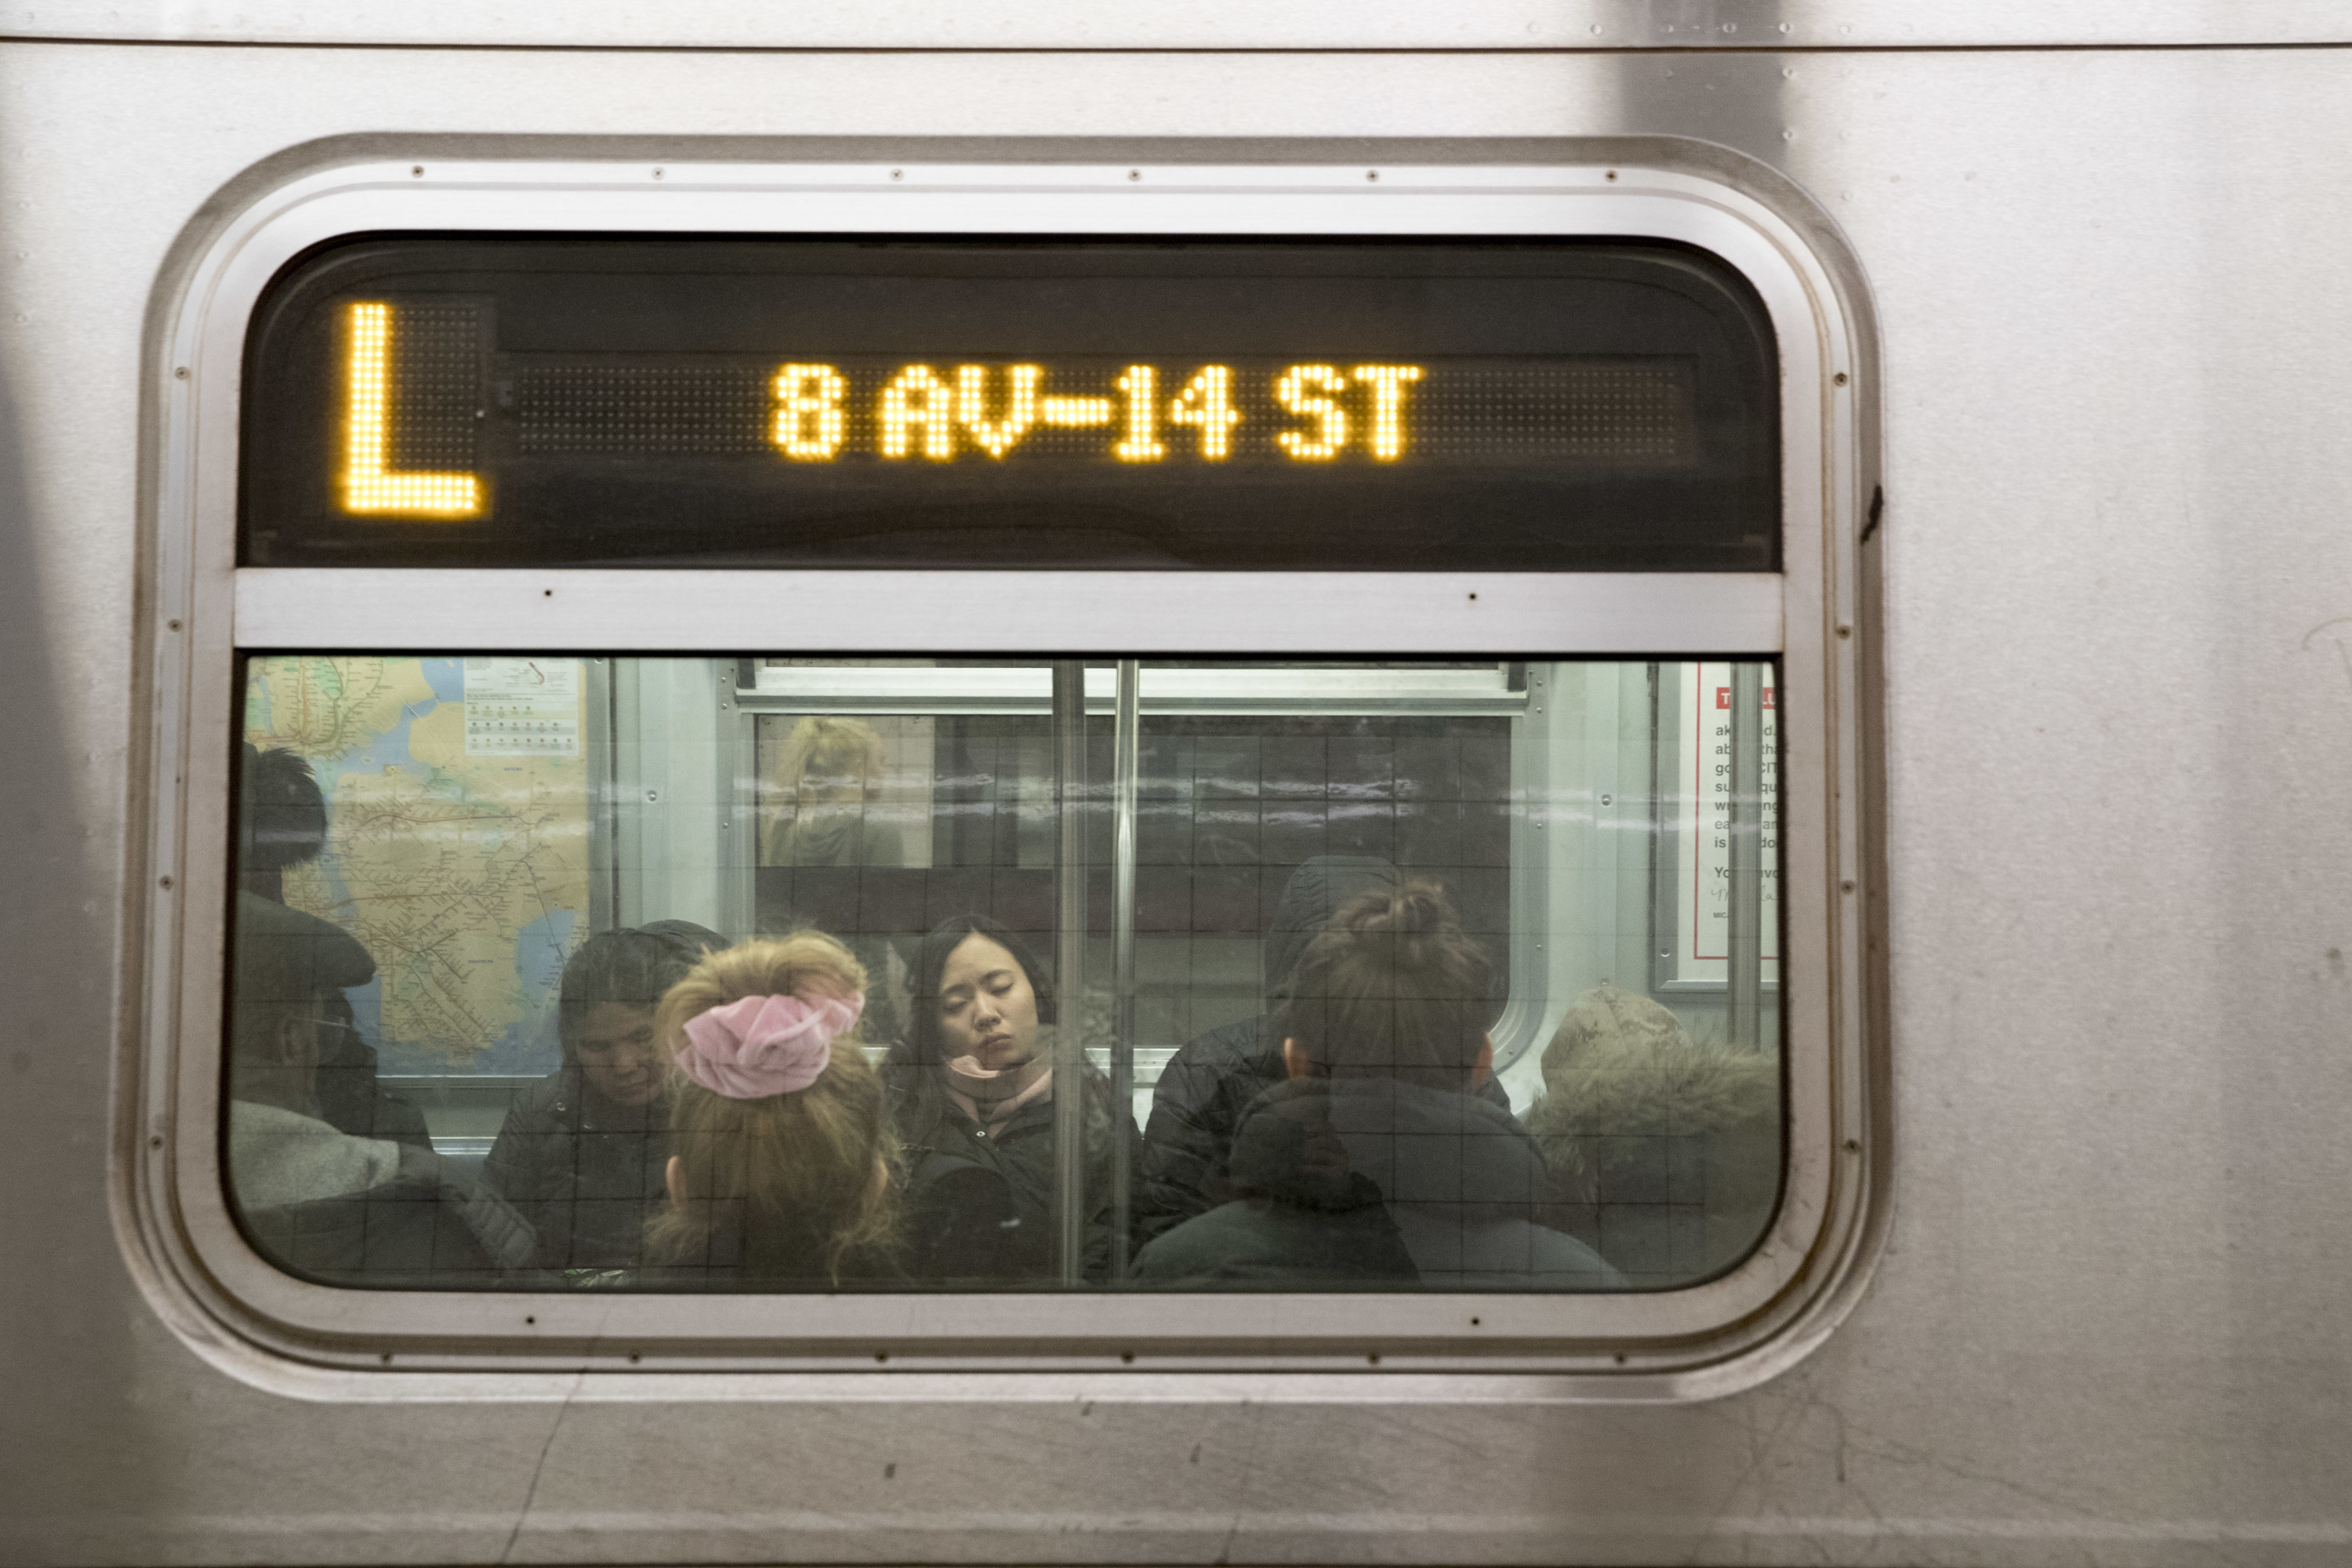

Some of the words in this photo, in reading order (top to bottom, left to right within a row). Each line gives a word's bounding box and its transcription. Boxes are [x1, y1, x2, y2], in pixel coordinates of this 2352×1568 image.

[343, 302, 481, 515] L
[771, 364, 847, 459] 8
[879, 364, 1240, 460] AV-14
[1276, 364, 1422, 459] ST
